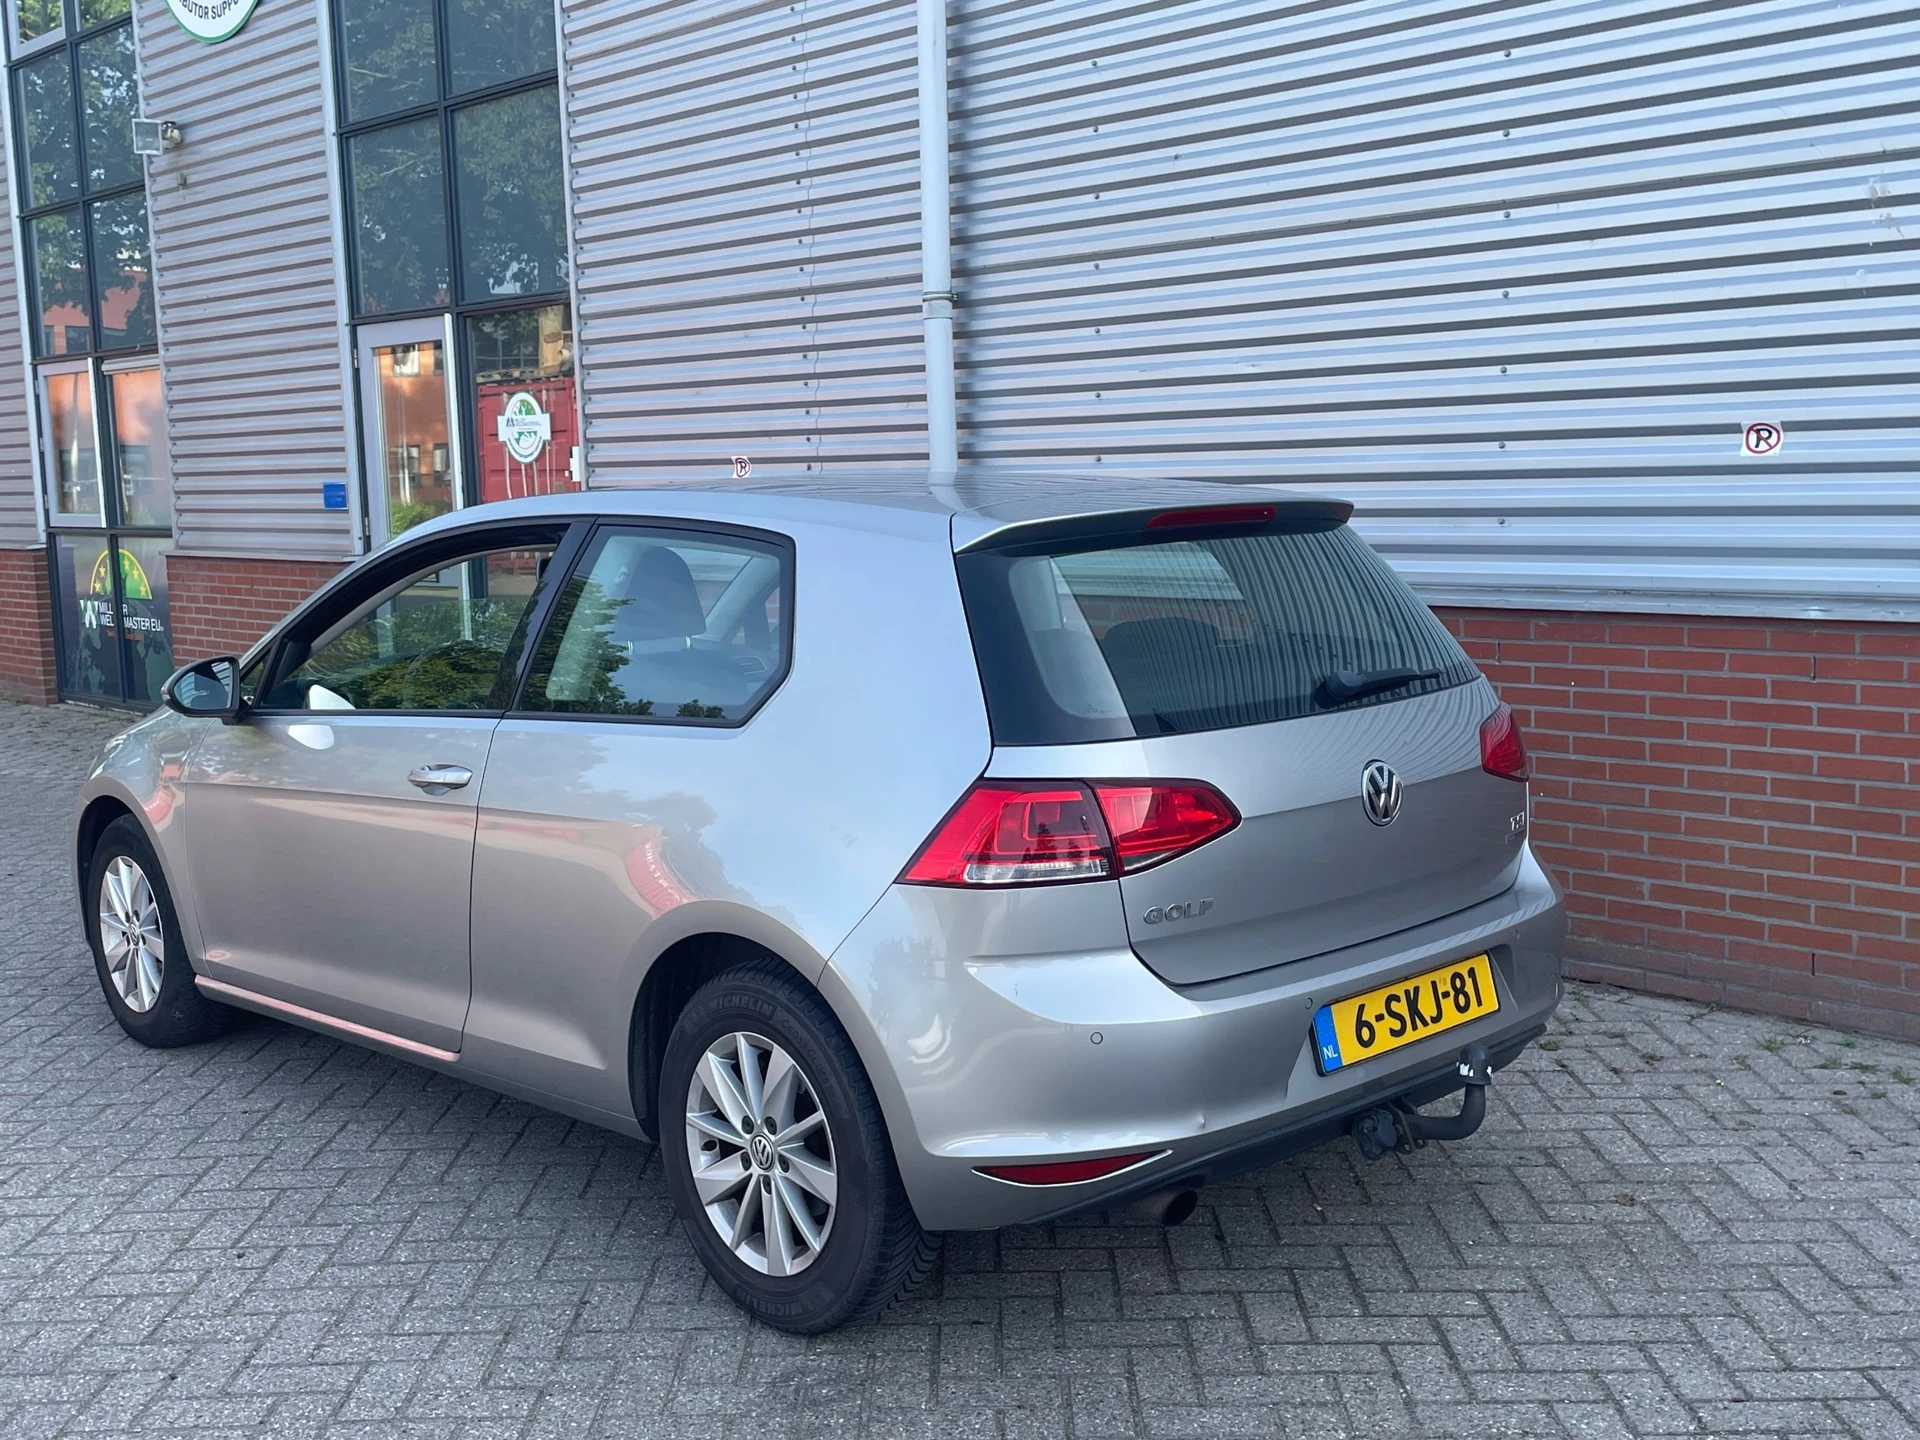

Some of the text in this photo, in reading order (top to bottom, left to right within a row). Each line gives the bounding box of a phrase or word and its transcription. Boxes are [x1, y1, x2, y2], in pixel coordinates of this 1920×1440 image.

[179, 0, 209, 20] BUTOR
[1143, 897, 1214, 925] GOLF
[707, 995, 774, 1018] MICHELIN
[1355, 967, 1483, 1049] 6-SKJ-81
[1323, 1045, 1338, 1061] NL
